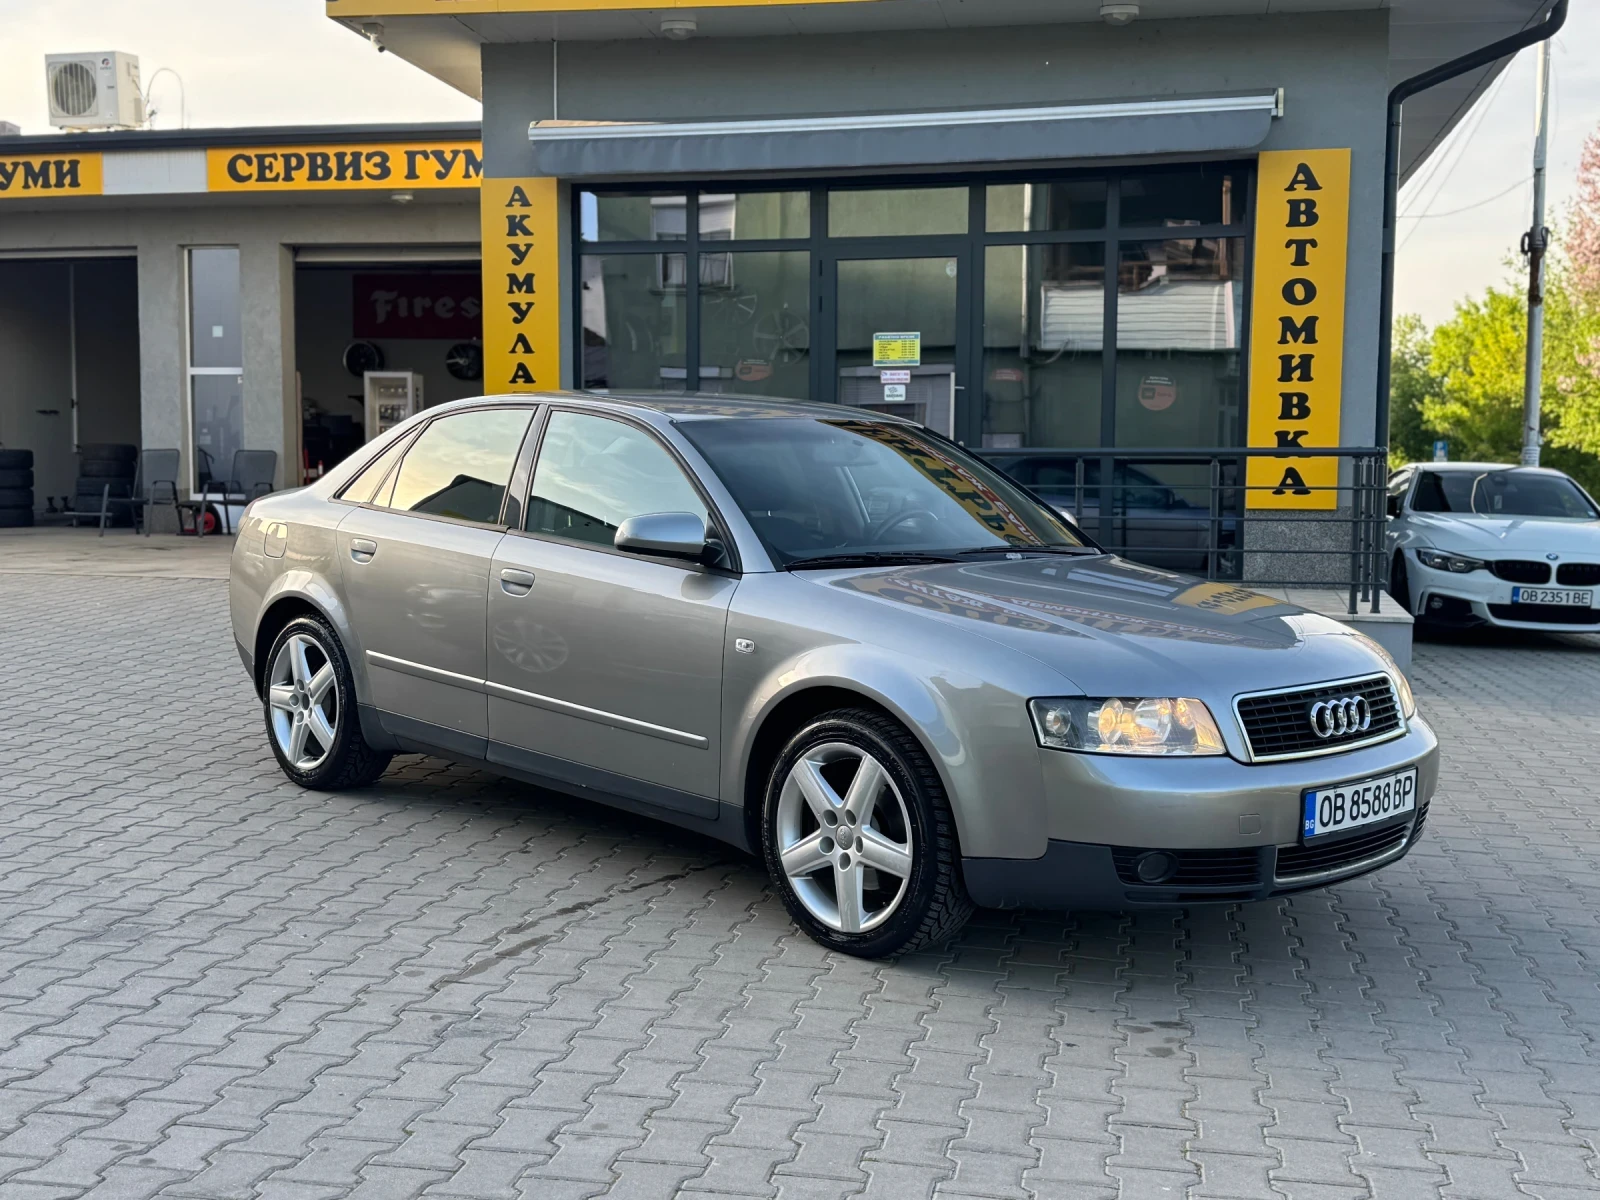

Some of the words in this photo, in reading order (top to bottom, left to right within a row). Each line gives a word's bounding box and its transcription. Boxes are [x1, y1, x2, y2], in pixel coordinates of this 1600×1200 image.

[0, 159, 81, 191] УМИ
[227, 150, 392, 183] СЕРВИЗ
[504, 185, 537, 394] АКУМУЛА
[1271, 162, 1324, 496] АВТОМИВКА
[1521, 590, 1538, 602] OB
[1540, 591, 1570, 604] 2351
[1572, 592, 1590, 605] BE
[1319, 792, 1346, 828] OB
[1349, 781, 1391, 821] 8588
[1393, 775, 1413, 811] BP
[1304, 820, 1315, 830] BG
